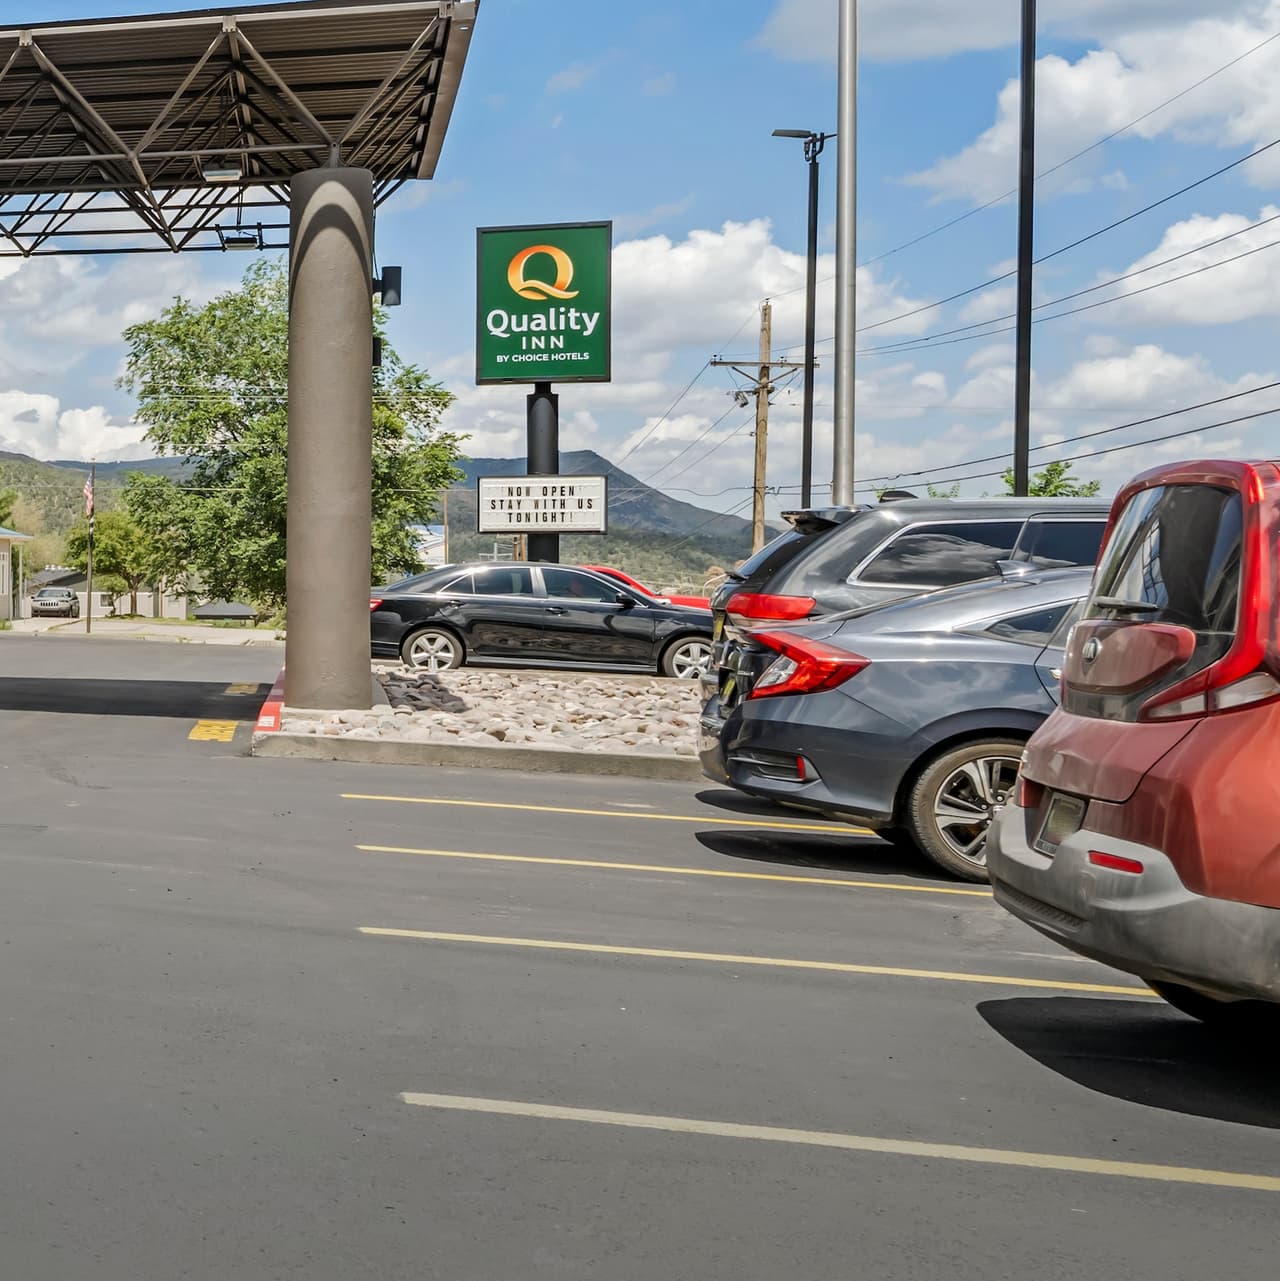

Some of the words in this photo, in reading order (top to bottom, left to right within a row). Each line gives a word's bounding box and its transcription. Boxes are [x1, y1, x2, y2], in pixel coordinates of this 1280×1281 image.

[507, 244, 580, 300] Q
[486, 307, 600, 338] Quality
[521, 335, 564, 350] INN
[496, 355, 510, 363] BY
[511, 354, 549, 362] CHOICE
[551, 352, 590, 360] HOTELS
[507, 486, 531, 497] NOW
[542, 486, 575, 496] OPEN
[490, 499, 522, 510] STAY
[533, 499, 566, 510] WITH
[577, 498, 593, 510] US
